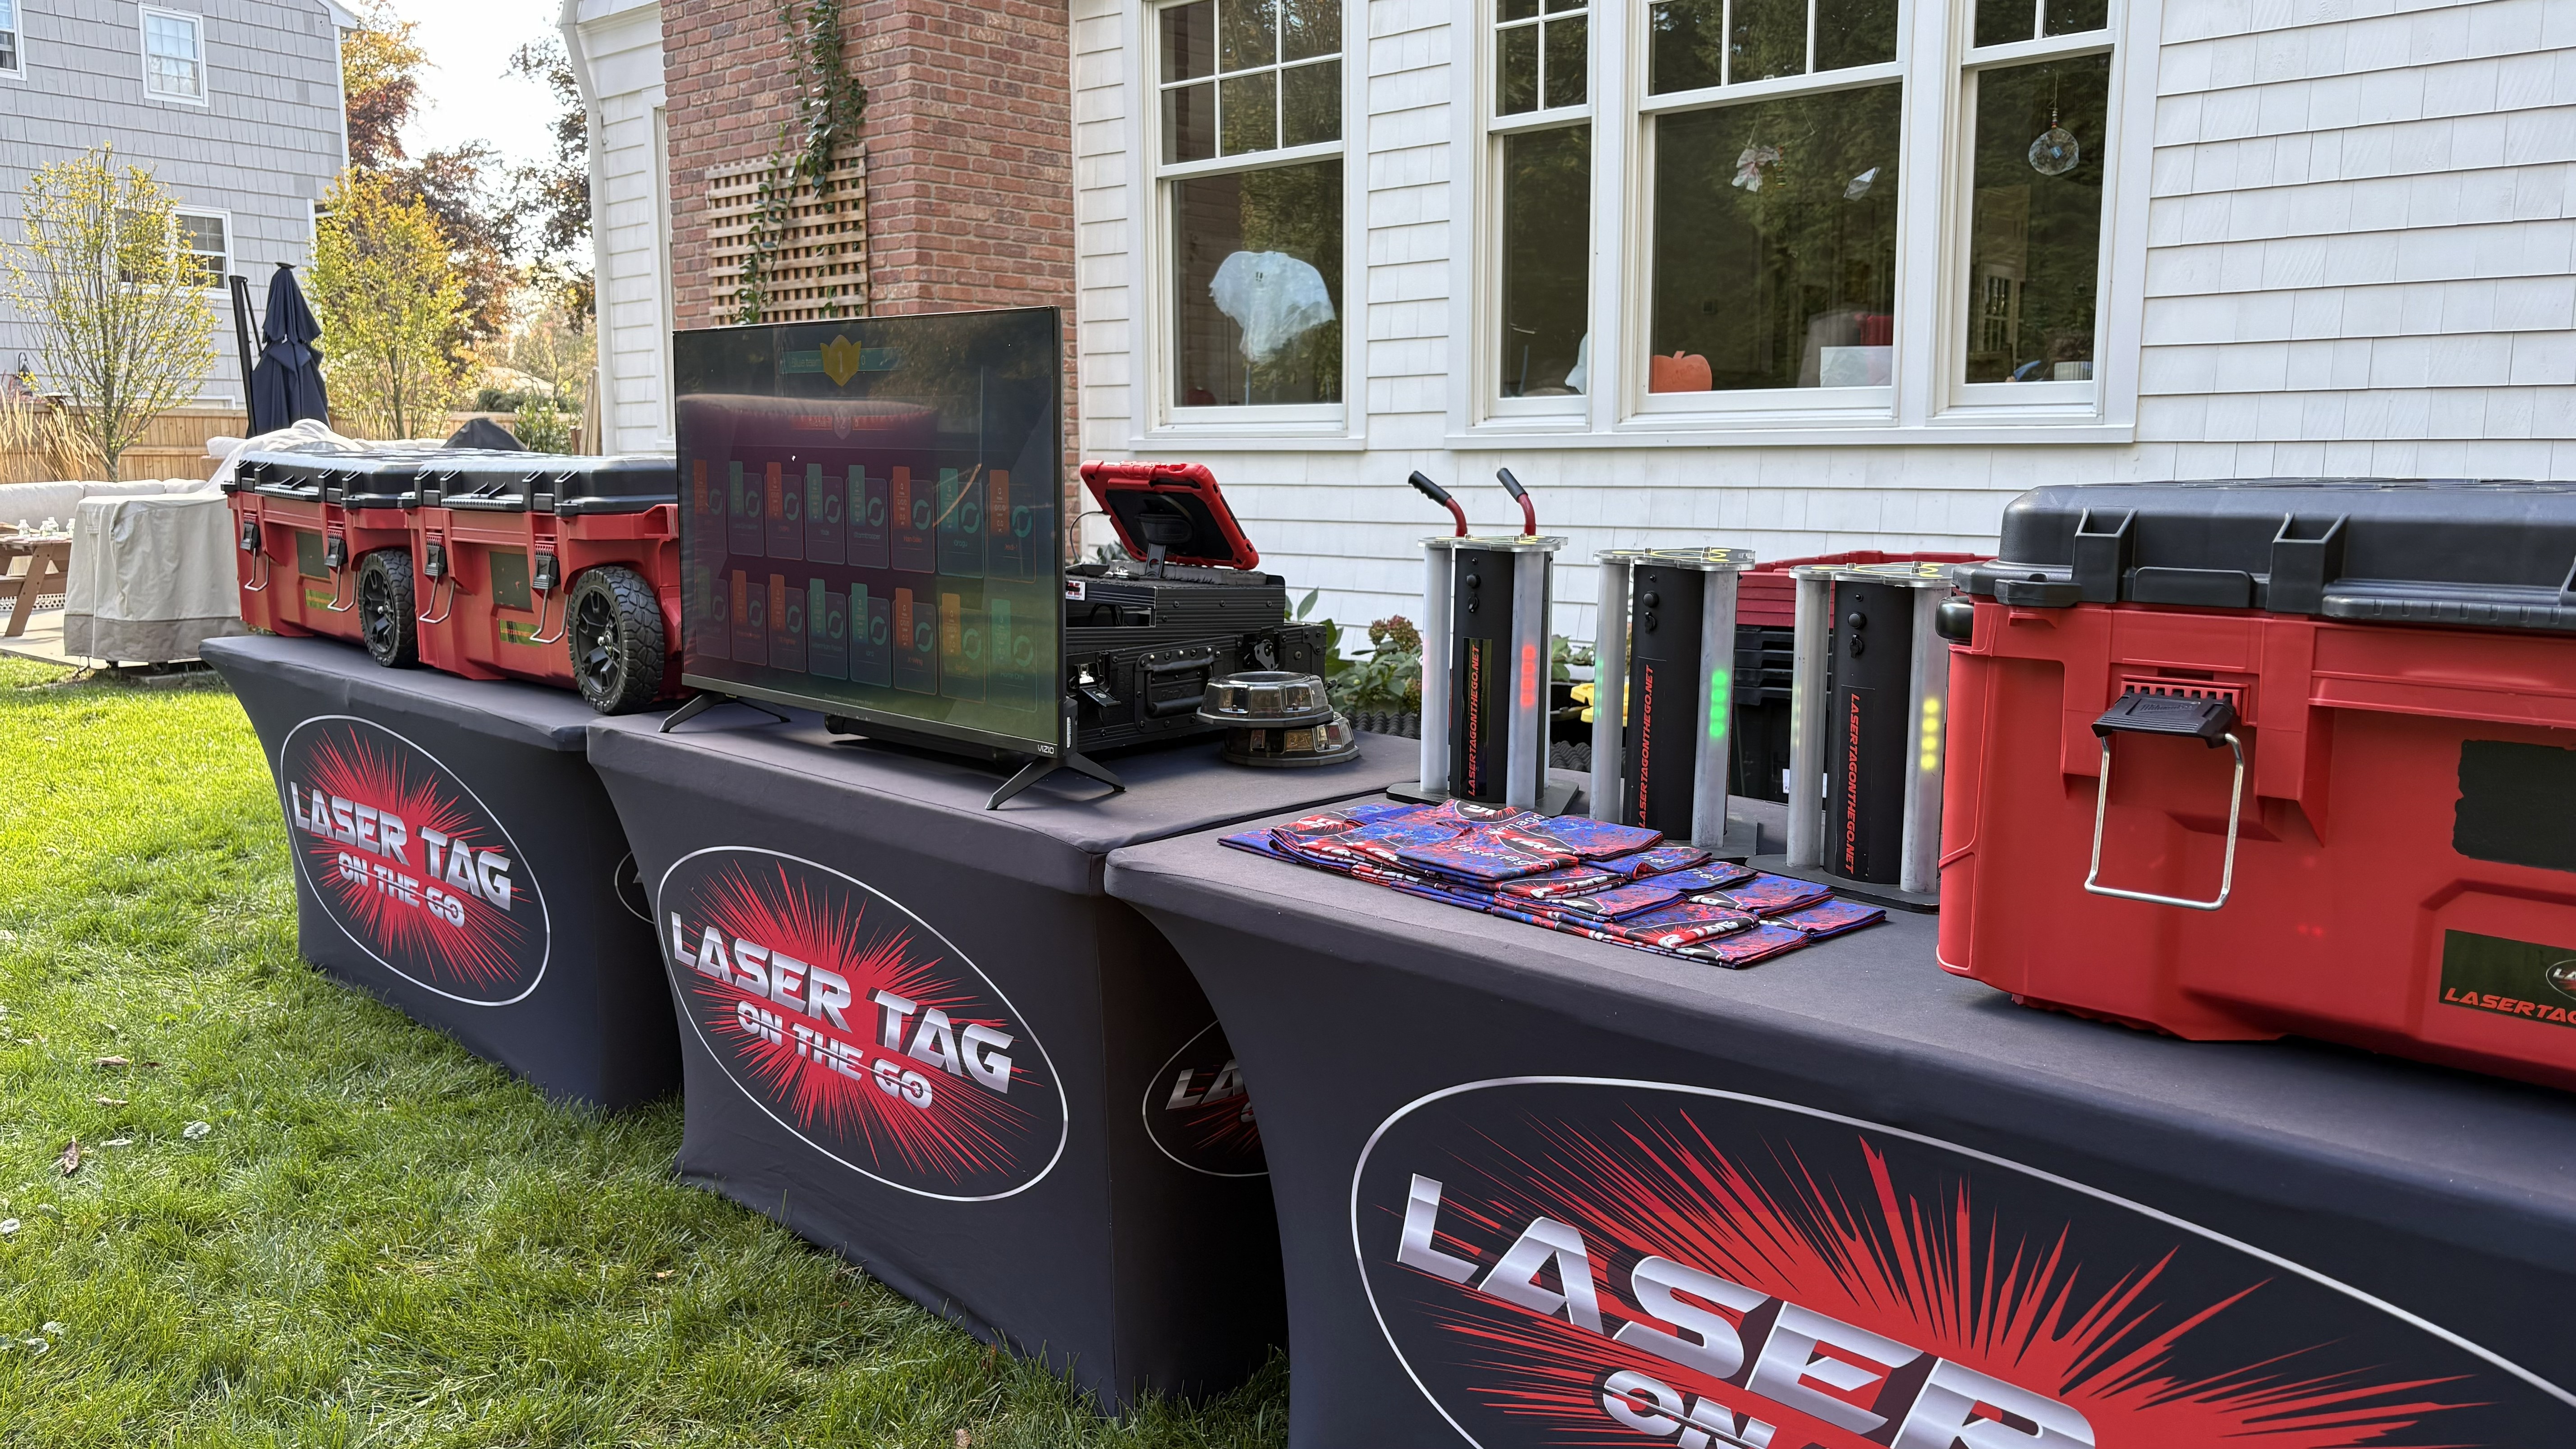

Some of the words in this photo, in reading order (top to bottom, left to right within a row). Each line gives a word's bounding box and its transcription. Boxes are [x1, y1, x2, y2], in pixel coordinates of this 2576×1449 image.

[1038, 744, 1054, 754] VIZIO
[1468, 644, 1480, 797] LASERTAGONTHEGO.NET
[1638, 664, 1654, 828] LASERTAGONTHEGO.NET
[1845, 693, 1860, 875] LASERTAGONTHEGO.NET
[290, 781, 410, 866] LASER
[420, 826, 512, 911] TAG
[339, 851, 368, 887] ON
[374, 865, 420, 908] THE
[427, 887, 465, 928] GO
[670, 911, 853, 1034] LASER
[874, 989, 1015, 1094] TAG
[737, 1000, 783, 1046] ON
[792, 1023, 864, 1081] THE
[874, 1058, 933, 1109] GO
[1397, 1173, 2095, 1449] LASER
[1602, 1369, 1777, 1449] ON
